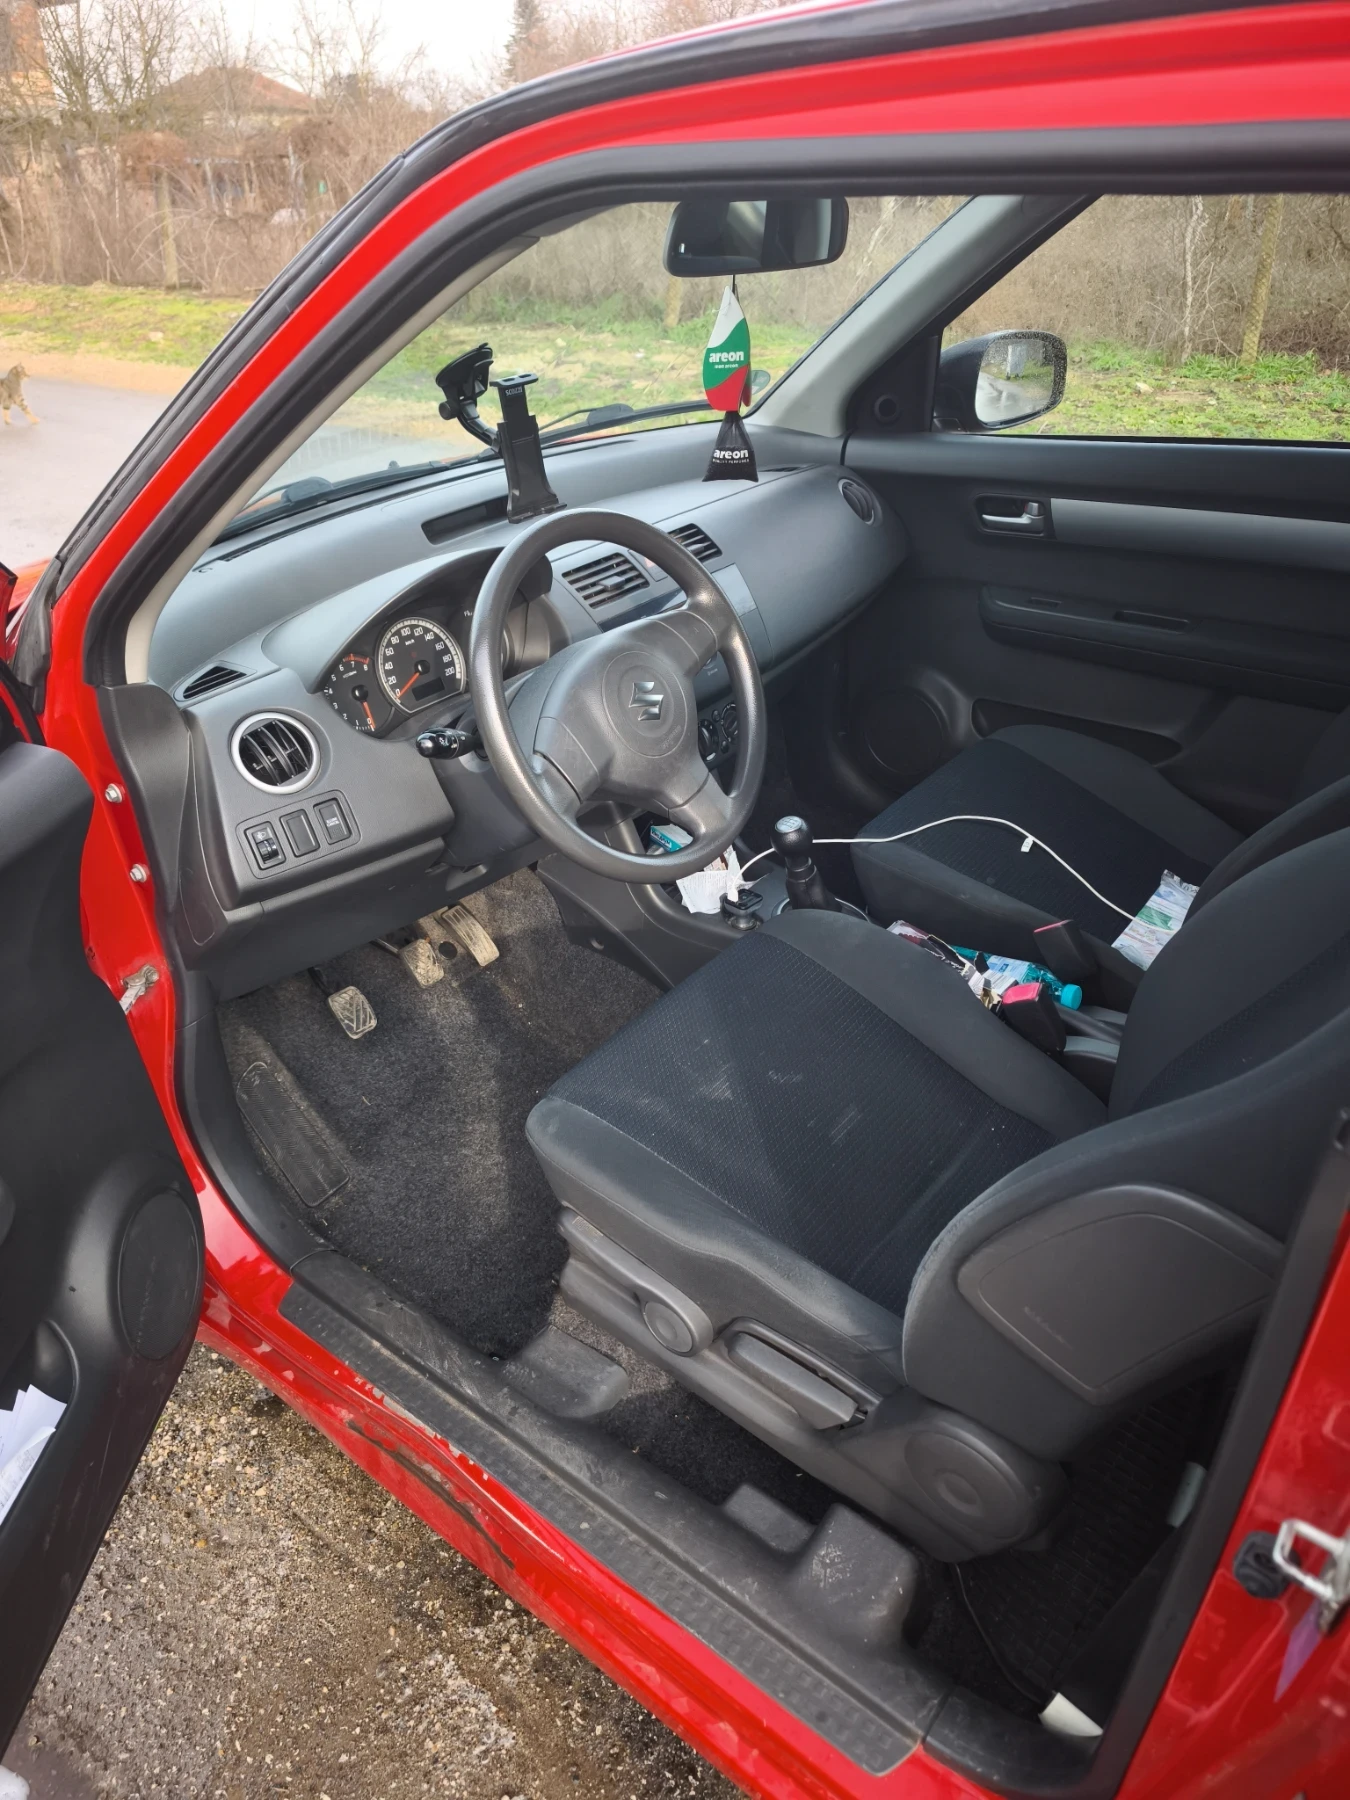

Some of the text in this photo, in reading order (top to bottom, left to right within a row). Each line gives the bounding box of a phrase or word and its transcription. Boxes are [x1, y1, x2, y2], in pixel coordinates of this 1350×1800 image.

[709, 351, 744, 362] areon
[713, 449, 749, 459] areon
[401, 627, 410, 636] 100
[414, 627, 423, 636] 120
[391, 636, 399, 644] 80
[424, 632, 434, 641] 140
[435, 642, 444, 650] 160
[385, 648, 394, 656] 60
[443, 654, 452, 663] 180
[385, 662, 393, 670] 40
[445, 667, 455, 676] 200
[388, 676, 396, 684] 20
